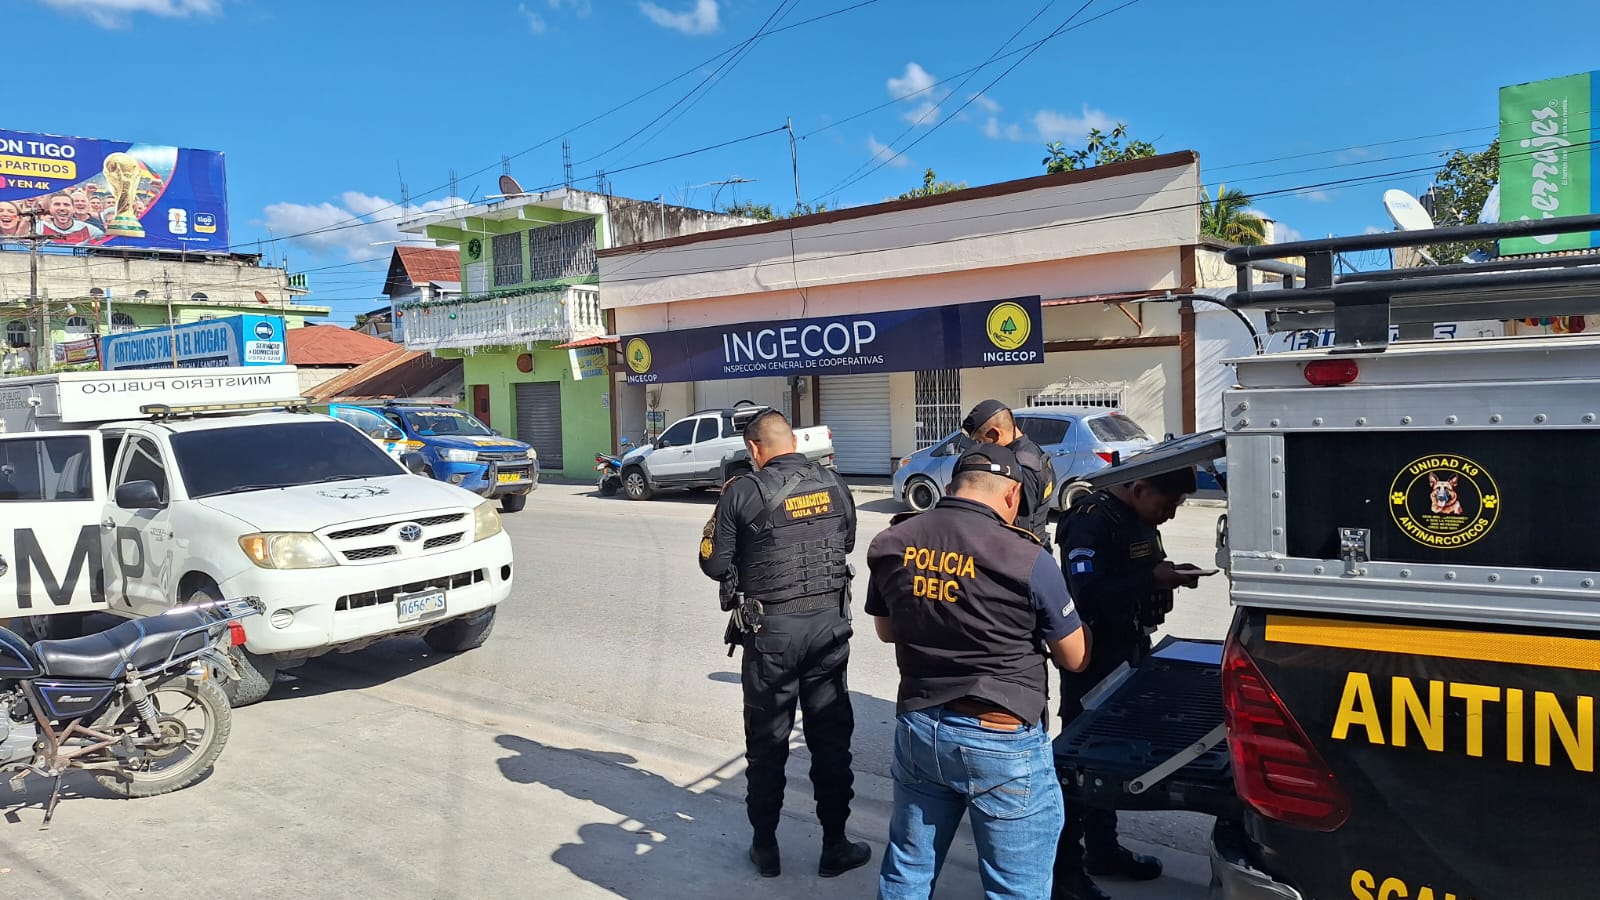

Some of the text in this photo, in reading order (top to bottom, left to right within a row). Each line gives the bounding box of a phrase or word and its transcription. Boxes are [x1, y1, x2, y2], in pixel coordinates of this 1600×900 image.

[26, 141, 75, 159] TIGO
[5, 160, 69, 174] PARTIDOS
[8, 178, 50, 190] Y EN 4K
[114, 336, 156, 363] ARTICULOS
[183, 332, 192, 355] EL
[194, 327, 228, 354] HOGAR
[723, 320, 876, 363] INGECOP
[723, 355, 884, 374] INSPECCIÓN GENERAL DE COOPERATIVAS
[983, 351, 1037, 363] INGECOP
[627, 374, 658, 383] INGECOP
[1409, 458, 1479, 477] UNIDAD K9
[792, 508, 812, 518] GUIA
[1399, 516, 1489, 545] ANTINARCOTICOS
[903, 546, 976, 579] POLICIA
[913, 575, 959, 603] DEIC
[1330, 671, 1594, 773] ANTIN
